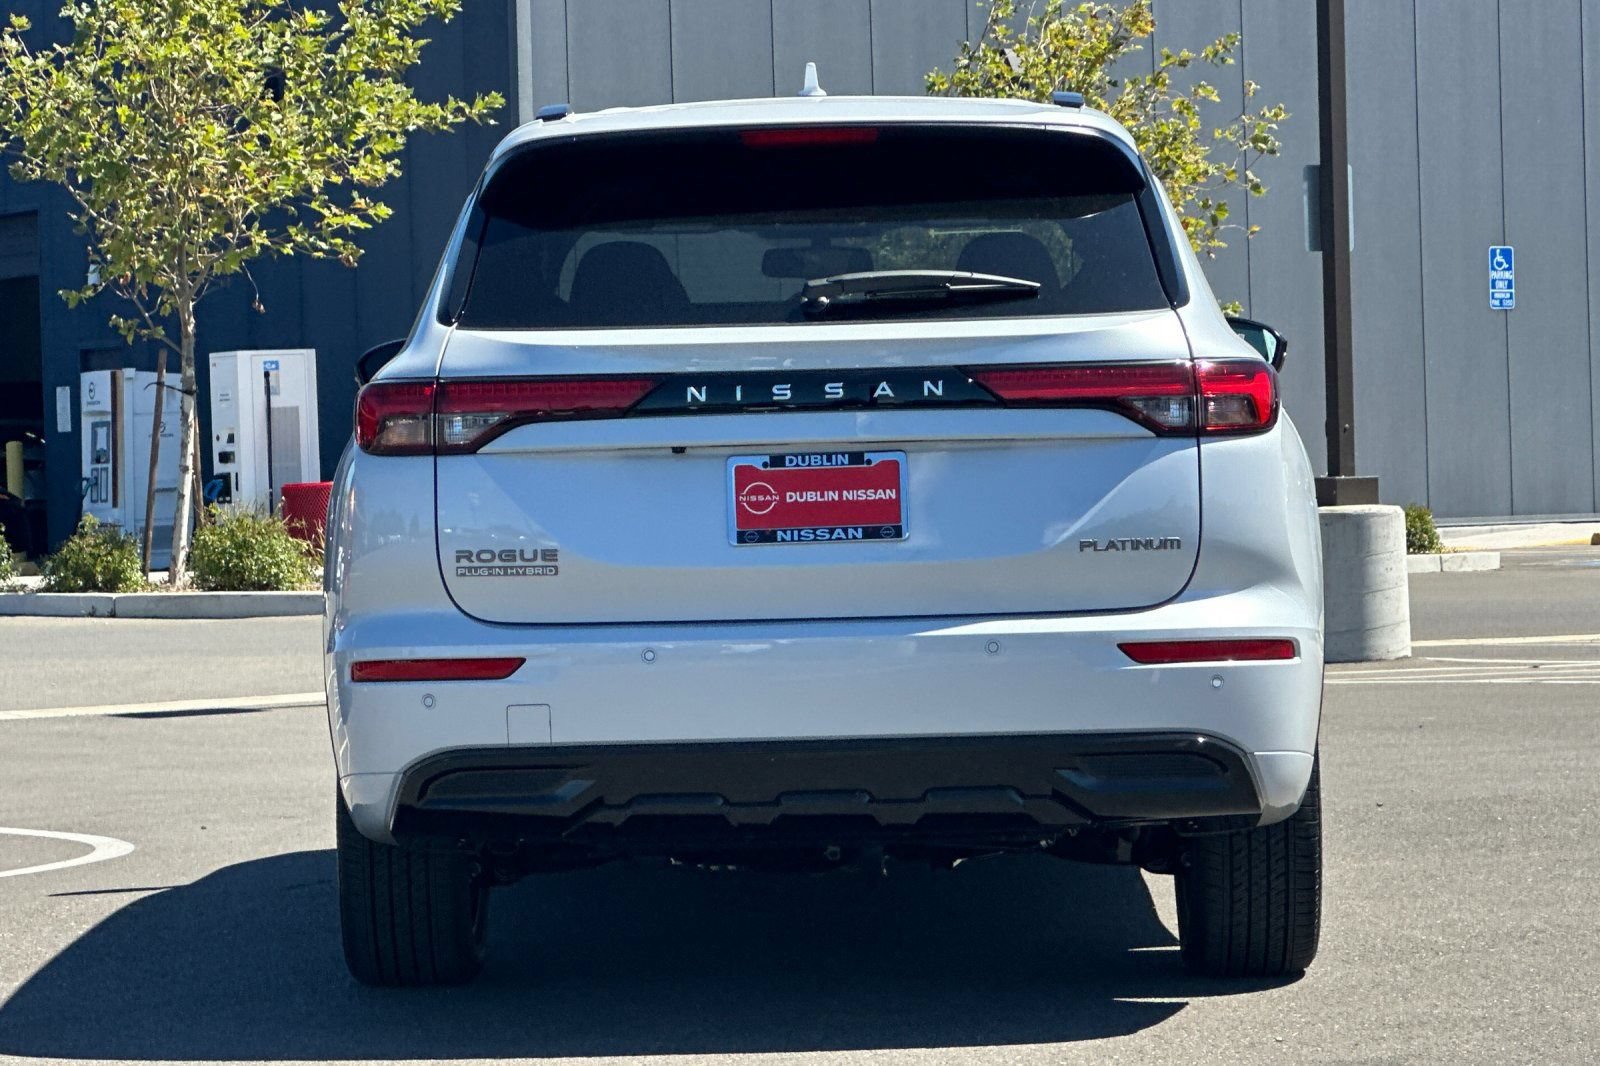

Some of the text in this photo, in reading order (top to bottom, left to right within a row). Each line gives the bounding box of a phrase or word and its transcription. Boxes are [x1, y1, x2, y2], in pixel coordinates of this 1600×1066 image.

[1491, 270, 1513, 280] PARKING
[1495, 280, 1509, 289] ONLY
[687, 380, 943, 403] NISSAN
[785, 453, 849, 467] DUBLIN
[739, 494, 780, 502] NISSAN
[786, 489, 897, 503] DUBLIN NISSAN
[776, 527, 863, 542] NISSAN
[1079, 536, 1182, 552] PLATINUM
[455, 548, 559, 563] ROGUE
[457, 567, 556, 576] PLUG-IN HYBRID
